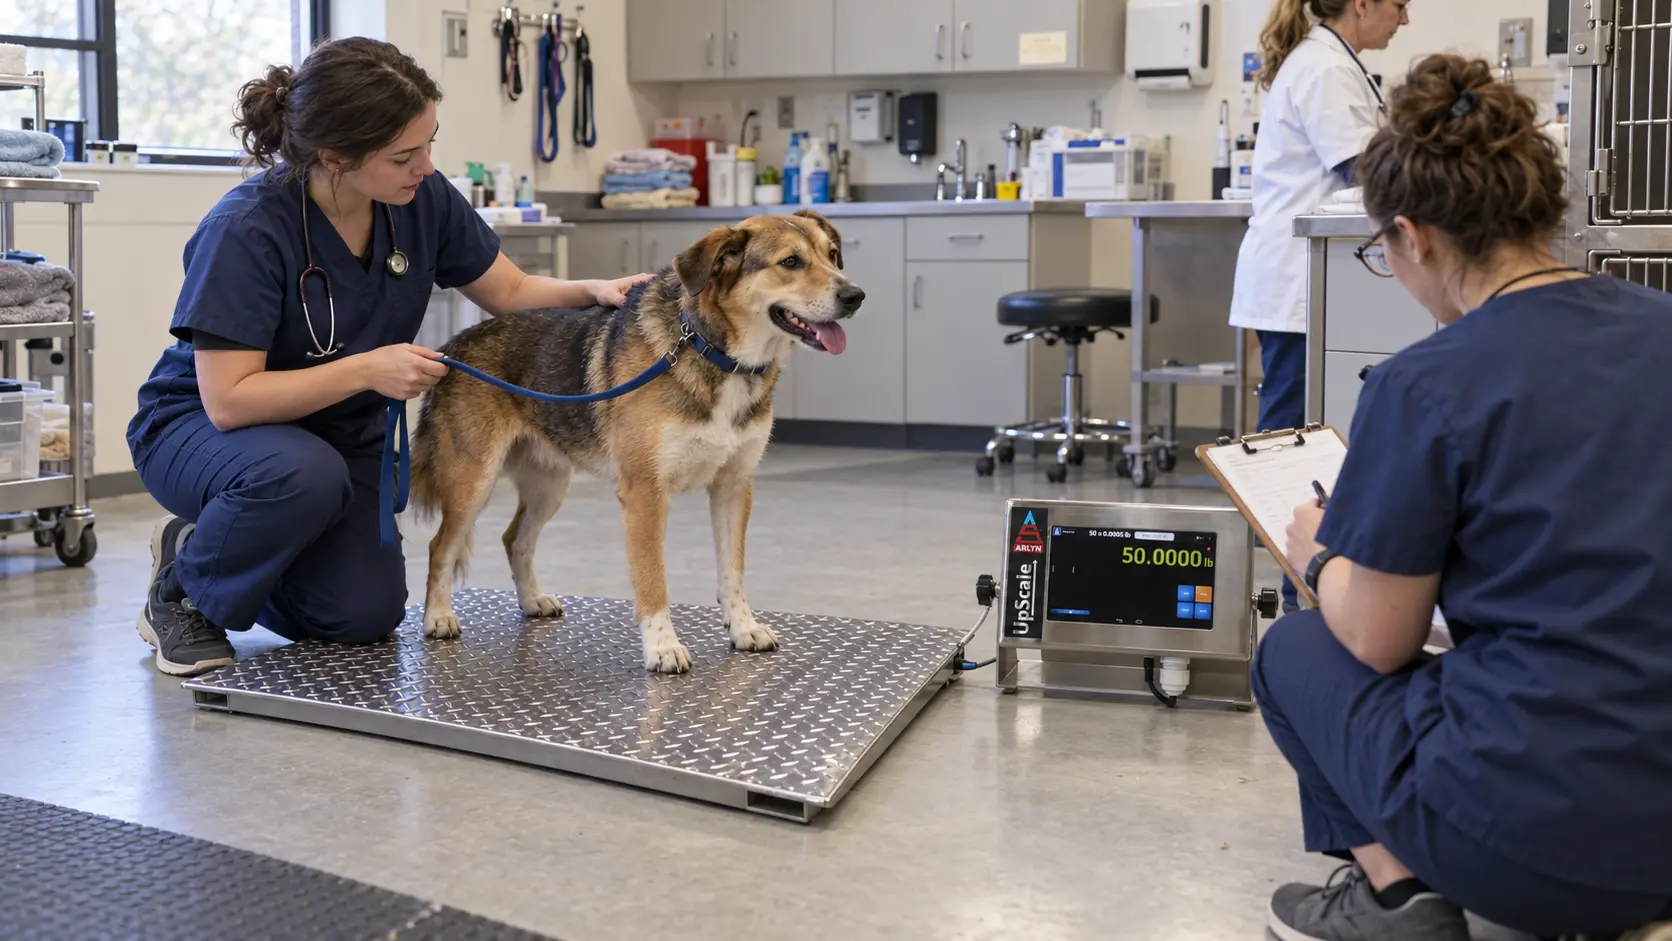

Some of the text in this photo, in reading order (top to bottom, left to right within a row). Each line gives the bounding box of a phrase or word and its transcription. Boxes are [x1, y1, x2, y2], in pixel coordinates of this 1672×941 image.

[1015, 544, 1042, 552] ARLYN
[1122, 546, 1214, 567] 50.0000 lb
[1013, 563, 1034, 635] UpScale
